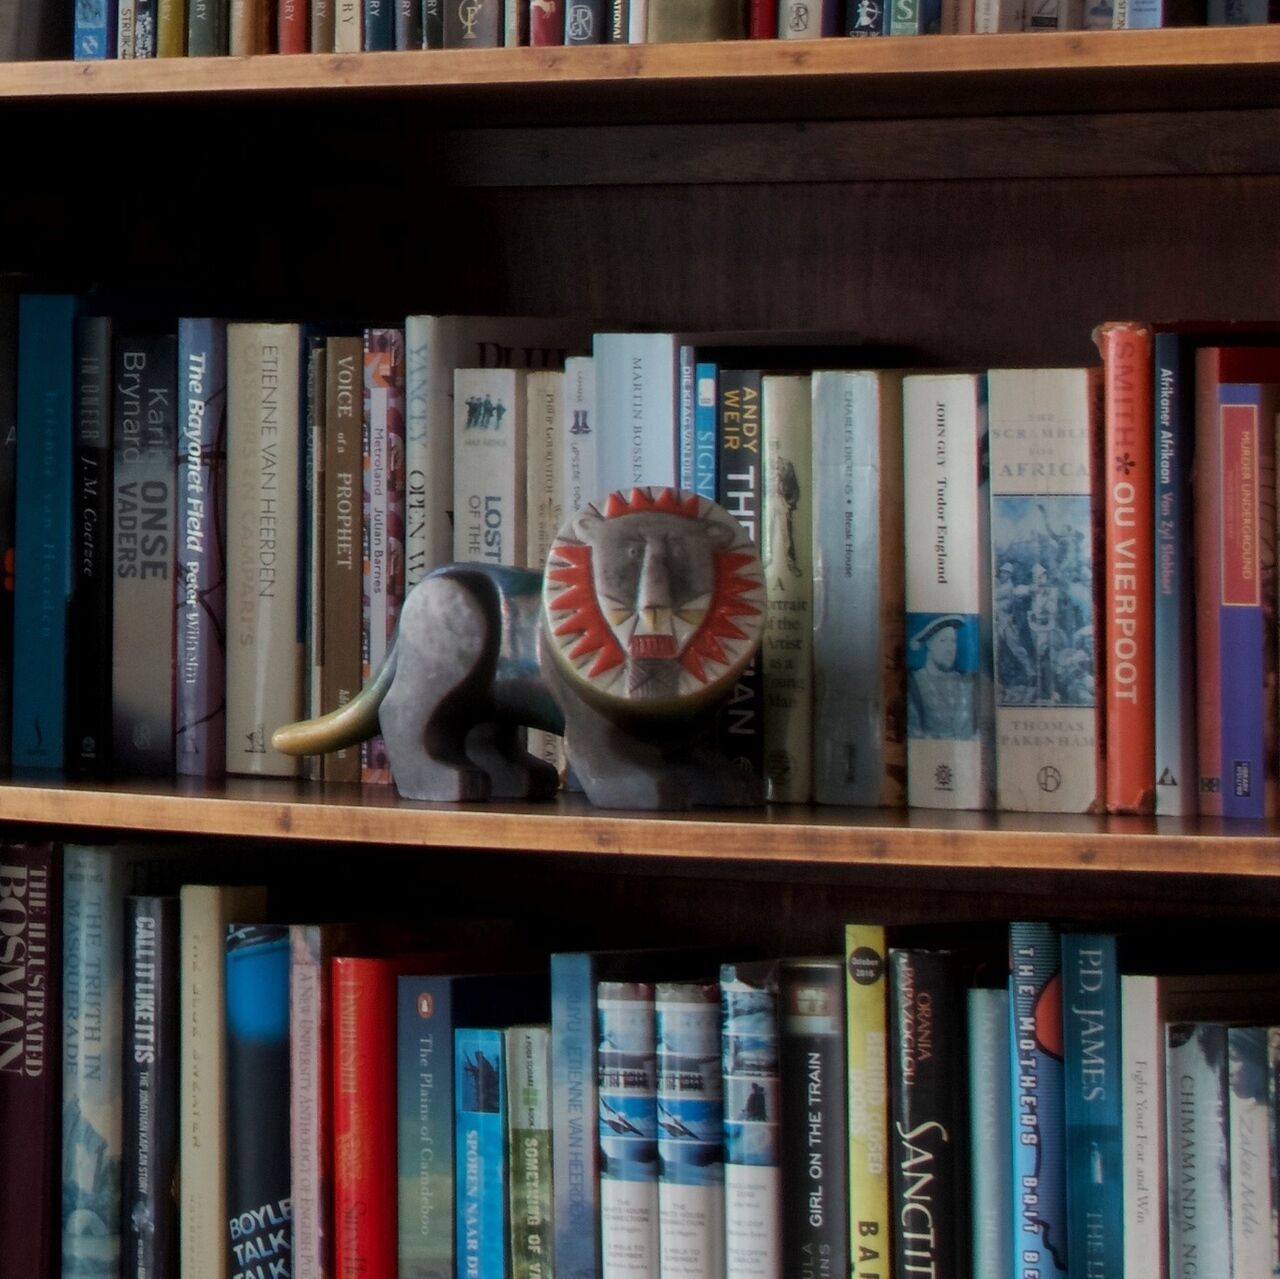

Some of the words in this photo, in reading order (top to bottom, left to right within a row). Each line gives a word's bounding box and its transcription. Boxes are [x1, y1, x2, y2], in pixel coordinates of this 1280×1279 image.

[337, 355, 354, 417] VOICE
[1159, 367, 1176, 426] Afrikaner
[723, 389, 740, 449] WEIR
[742, 386, 758, 455] ANDY
[373, 427, 384, 495] Metroland
[117, 482, 138, 578] VADERS
[336, 472, 353, 569] PROPHET
[373, 507, 385, 545] Julian
[935, 477, 949, 522] Tudor
[1114, 482, 1138, 528] OU
[140, 481, 170, 581] ONSE
[258, 499, 276, 598] HEERDEN
[935, 526, 950, 584] England
[373, 549, 384, 593] Barnes
[1112, 537, 1137, 705] VIERPOOT
[808, 1052, 824, 1104] TRAIN
[1018, 1017, 1038, 1145] MOTHERS
[1073, 1007, 1104, 1101] JAMES
[809, 1111, 823, 1146] THE
[417, 1148, 433, 1234] Camdeboo
[809, 1152, 823, 1179] ON
[808, 1184, 824, 1227] GIRL
